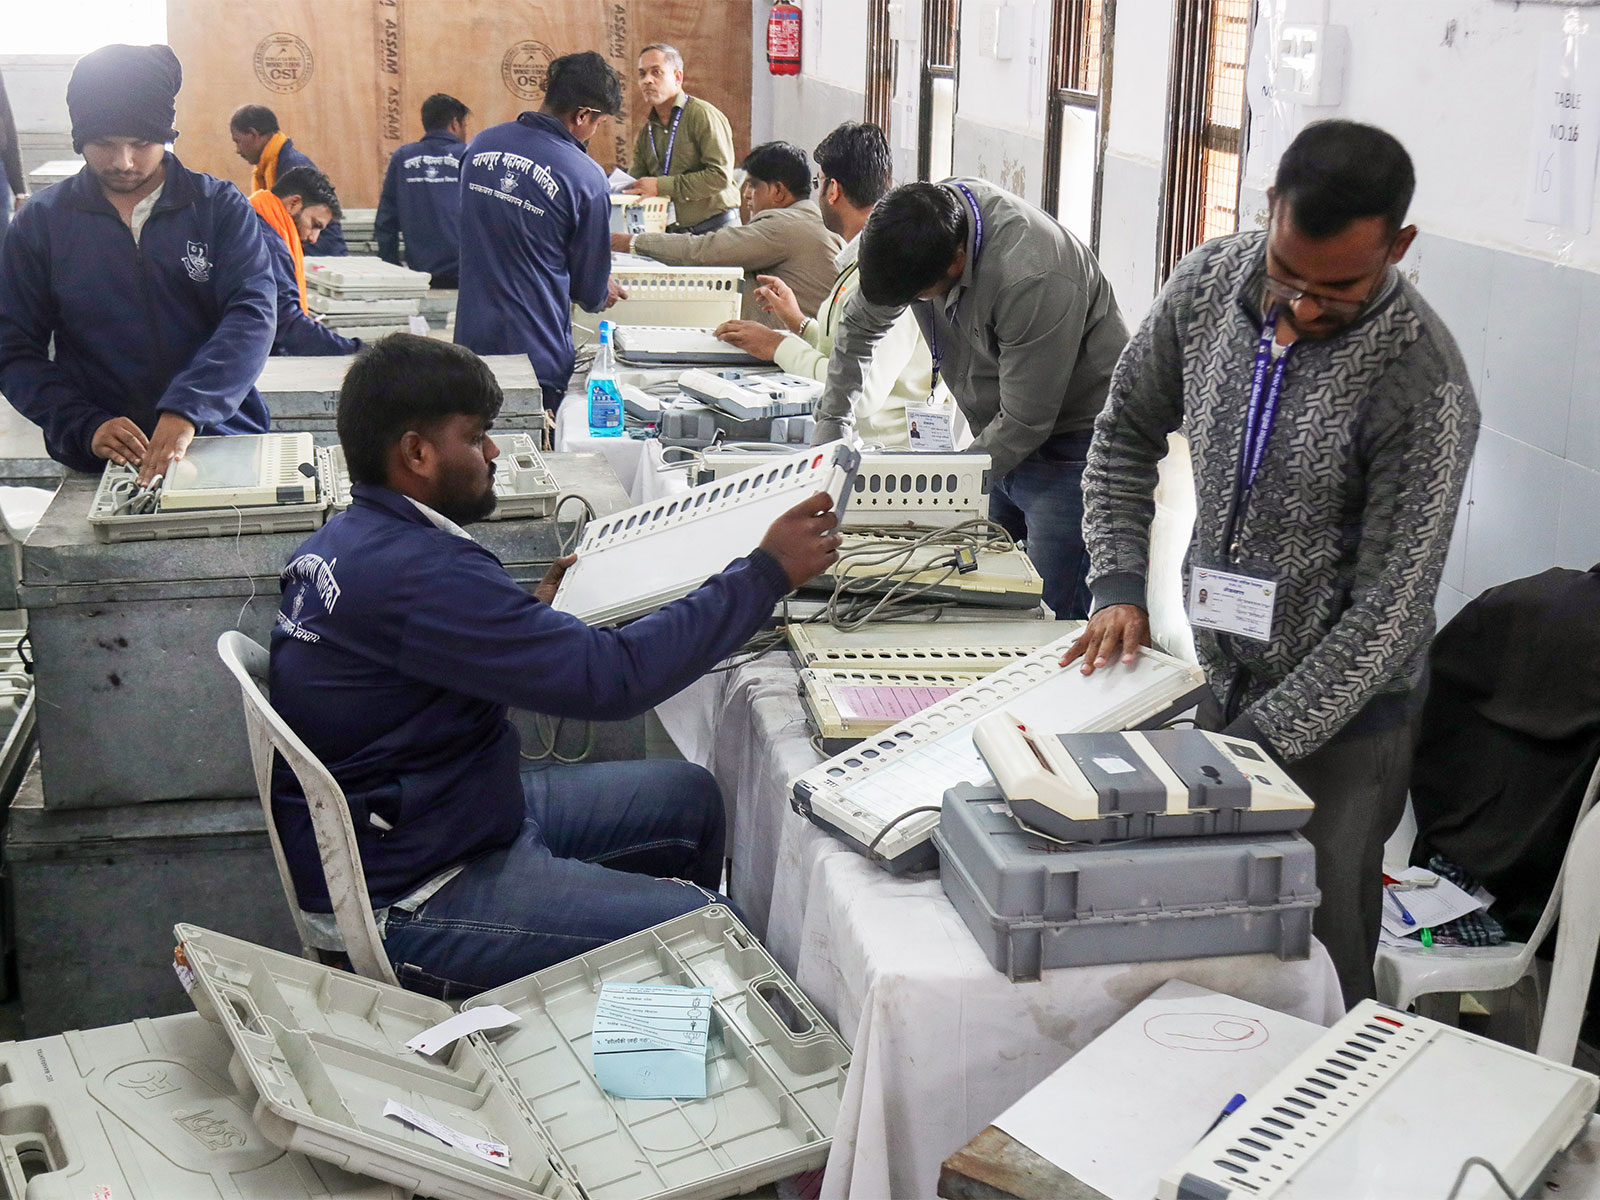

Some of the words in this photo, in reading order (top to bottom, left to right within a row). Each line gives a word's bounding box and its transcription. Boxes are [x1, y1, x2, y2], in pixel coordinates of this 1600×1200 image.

[385, 19, 399, 74] ASSAM
[614, 3, 626, 58] ASSAM
[270, 68, 298, 80] ISO
[518, 76, 542, 87] SO
[388, 86, 400, 140] ASSAM
[1554, 91, 1581, 110] TABLE
[1549, 124, 1579, 142] NO.16
[472, 151, 503, 171] नागपूर
[502, 152, 534, 175] महानगर
[532, 165, 560, 200] पालिका
[1534, 151, 1555, 194] 16
[523, 199, 545, 217] विभाग
[315, 557, 341, 615] पालिका
[293, 621, 320, 643] विभाग
